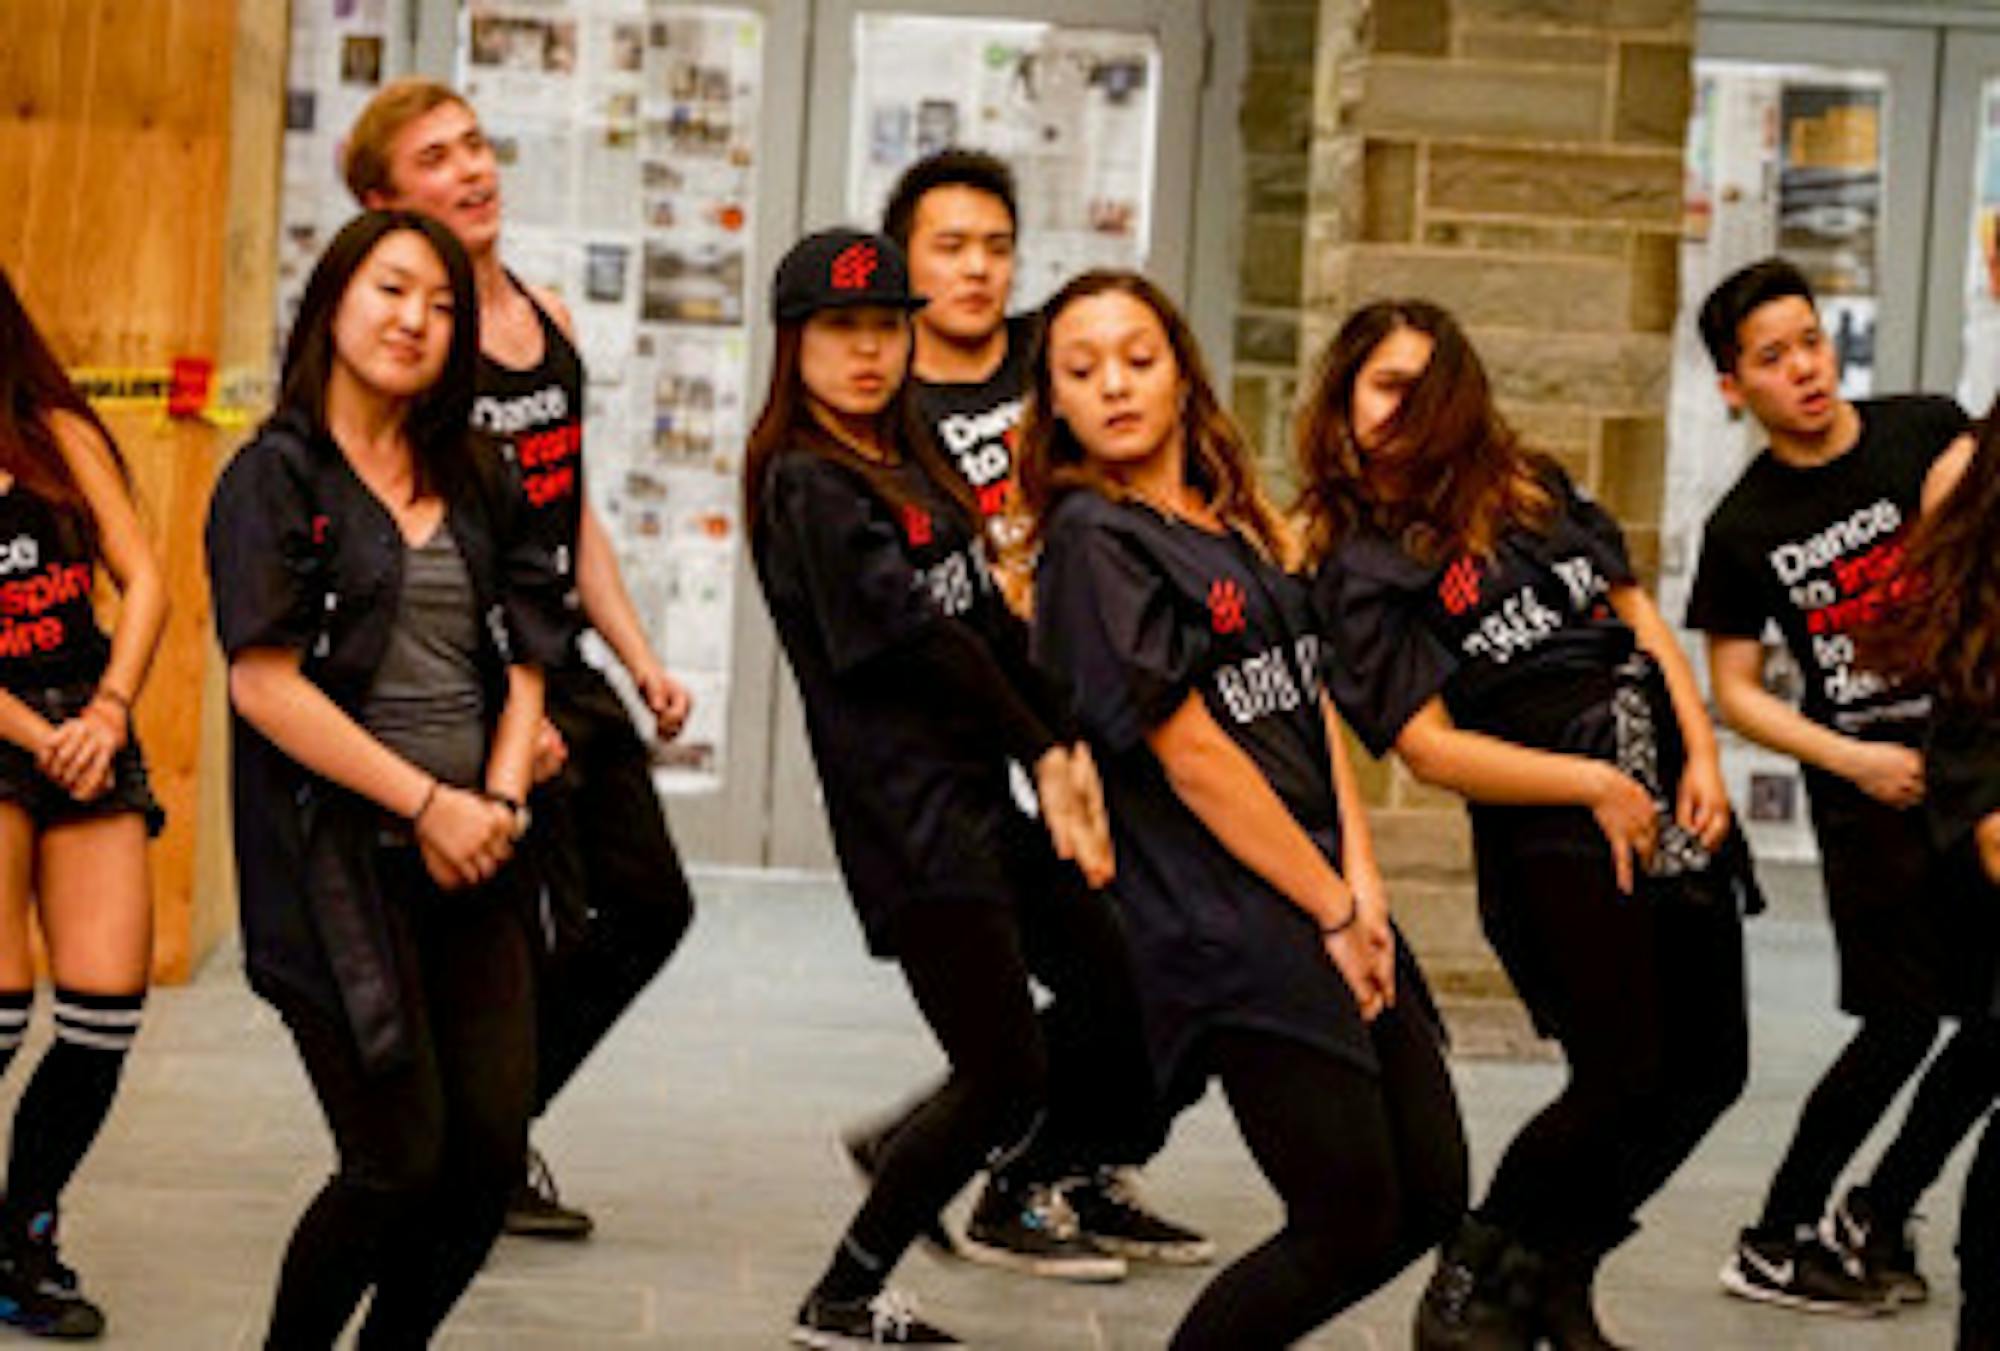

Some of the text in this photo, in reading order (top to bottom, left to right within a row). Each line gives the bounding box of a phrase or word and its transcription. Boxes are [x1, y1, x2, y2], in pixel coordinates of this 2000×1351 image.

[471, 385, 568, 432] Dance
[960, 443, 1009, 486] to
[1769, 499, 1901, 586] Dance
[1812, 635, 1855, 669] to
